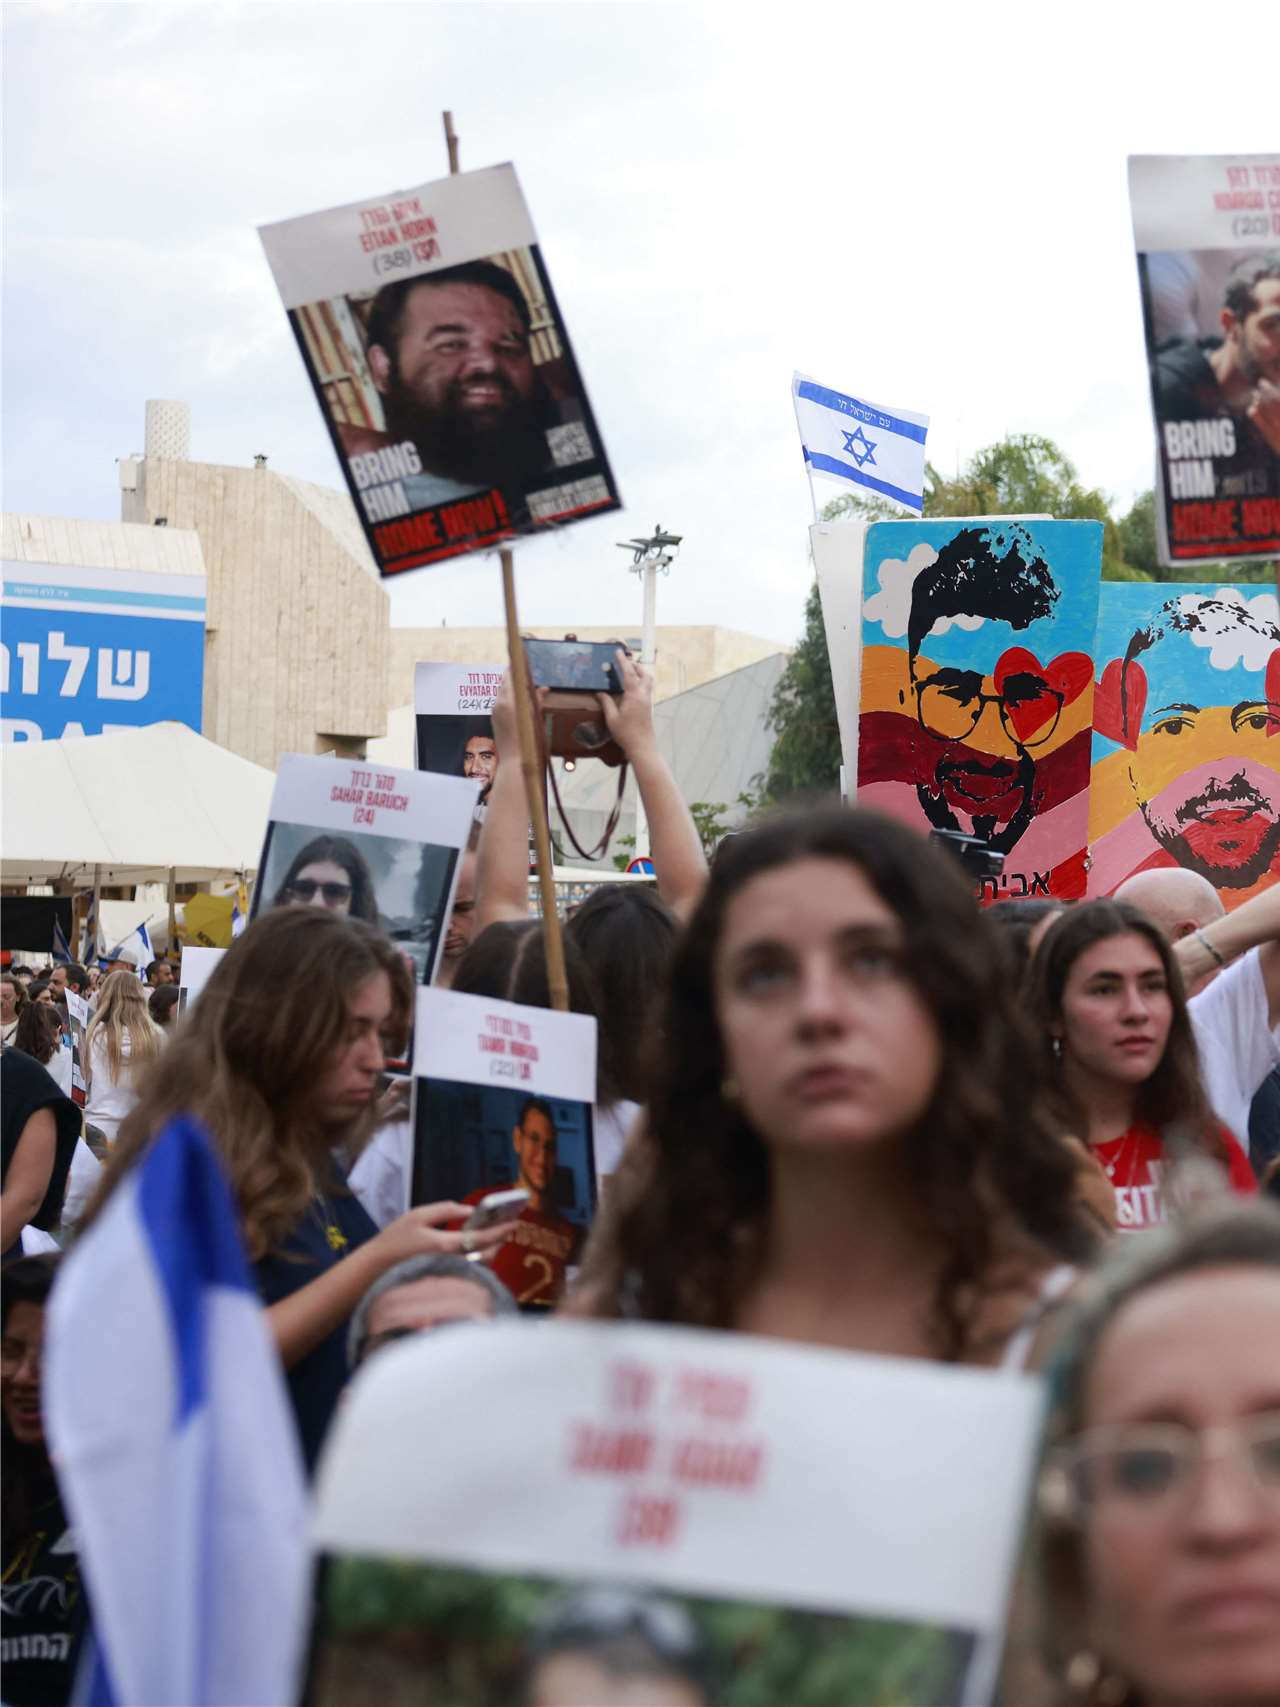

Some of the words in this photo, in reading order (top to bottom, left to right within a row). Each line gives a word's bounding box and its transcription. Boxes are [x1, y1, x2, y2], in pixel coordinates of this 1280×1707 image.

[837, 398, 849, 411] חי
[849, 400, 877, 421] ישראל
[879, 415, 892, 429] עם
[1164, 417, 1237, 460] BRING
[347, 440, 424, 492] BRING
[1168, 458, 1216, 499] HIM
[359, 479, 413, 524] HIM
[373, 511, 444, 559] HOME
[1172, 500, 1239, 543] HOME
[0, 631, 151, 702] שלו
[468, 672, 480, 685] דוד
[459, 685, 491, 697] EVYATAR
[330, 785, 364, 804] SAHAR
[366, 791, 409, 813] BARUCH
[978, 870, 1052, 900] אבית
